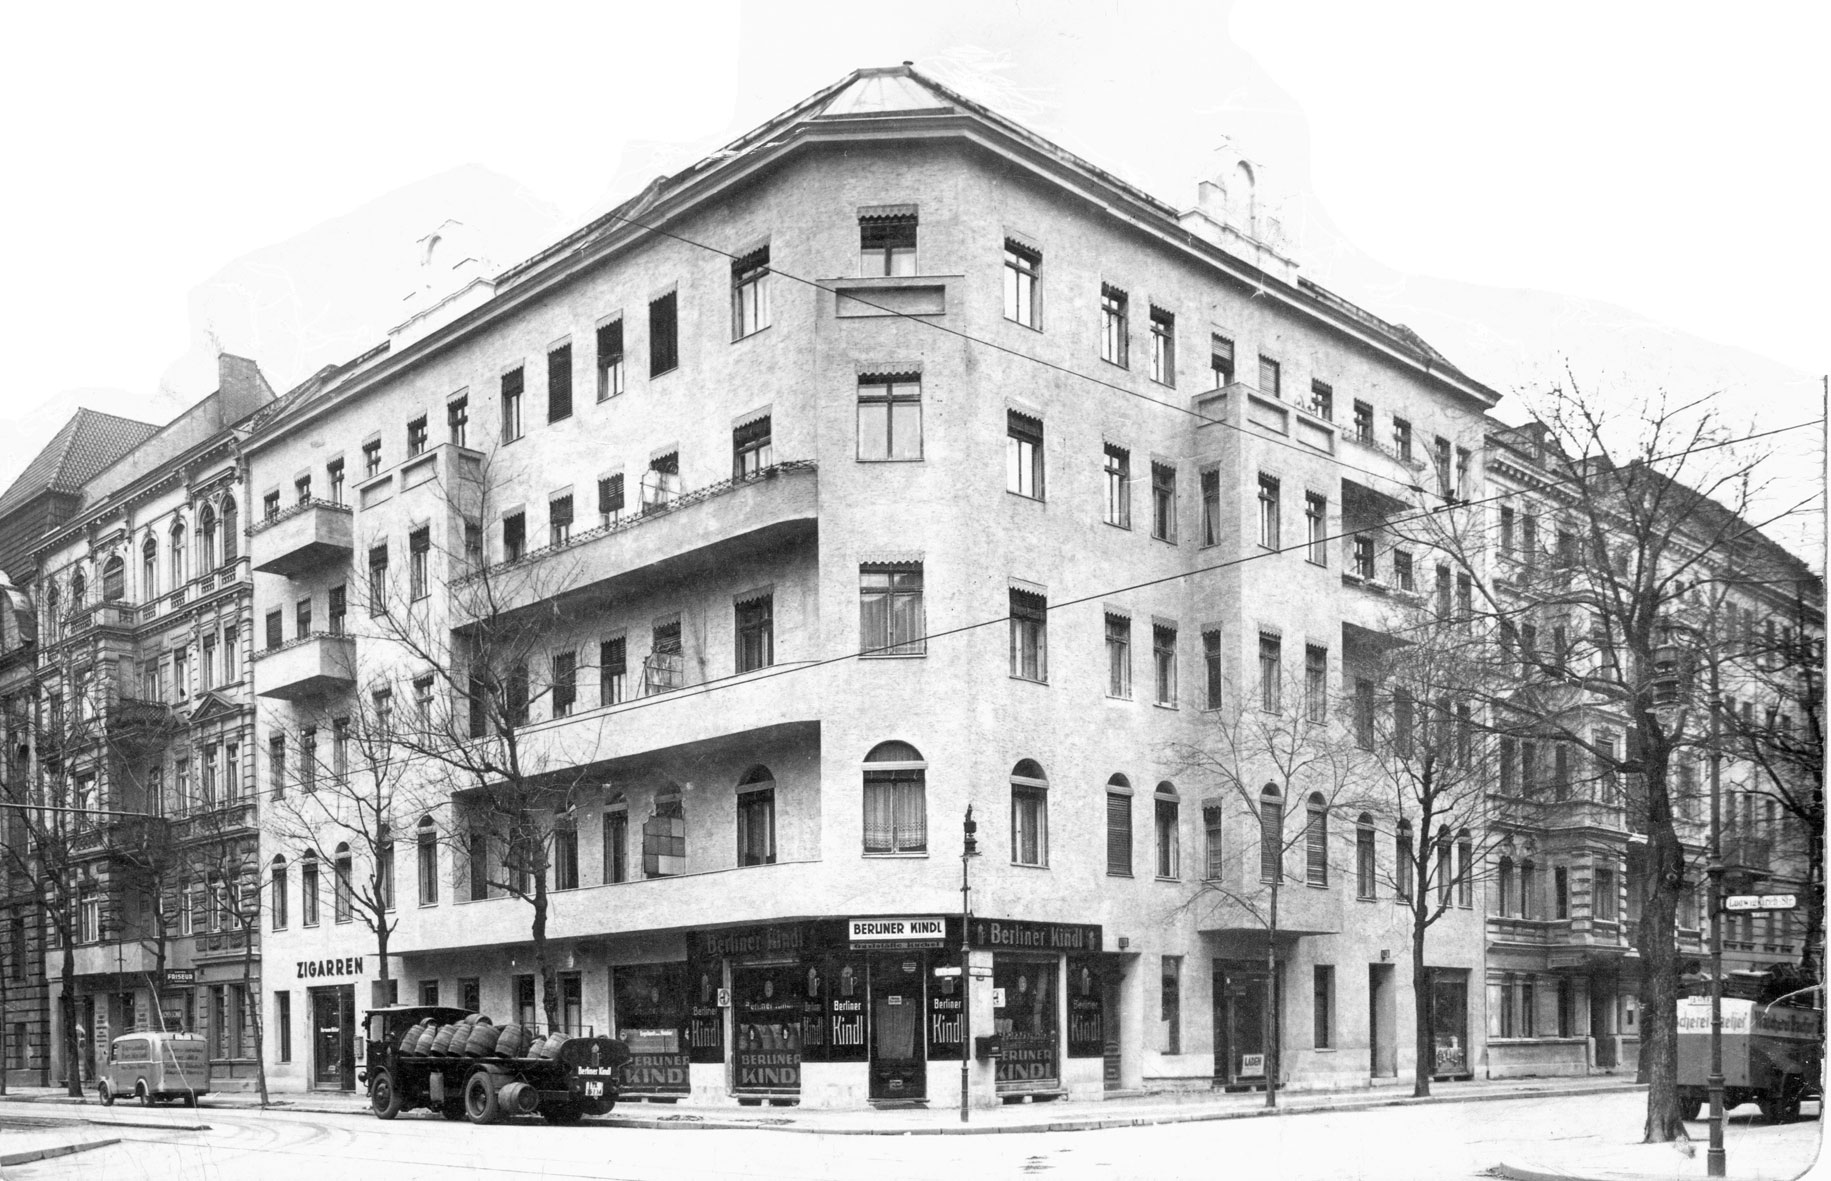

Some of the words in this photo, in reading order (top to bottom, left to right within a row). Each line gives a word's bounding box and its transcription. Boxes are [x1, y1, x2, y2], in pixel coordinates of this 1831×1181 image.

[853, 922, 905, 935] BERLINER
[910, 921, 942, 934] KINDL
[990, 922, 1045, 946] Berliner
[1051, 926, 1083, 948] Kindl
[296, 956, 363, 979] ZIGARREN
[692, 1005, 718, 1016] Berliner
[833, 1000, 861, 1011] Berliner
[934, 998, 961, 1009] Berliner
[691, 1019, 720, 1047] Kindl
[832, 1015, 864, 1045] Kindl
[933, 1013, 964, 1043] Kindl
[1071, 1014, 1100, 1042] Kindl
[630, 1055, 690, 1066] ERLINER
[1001, 1049, 1052, 1061] ERLINER
[578, 1065, 598, 1075] Berliner
[598, 1066, 612, 1076] Kindl
